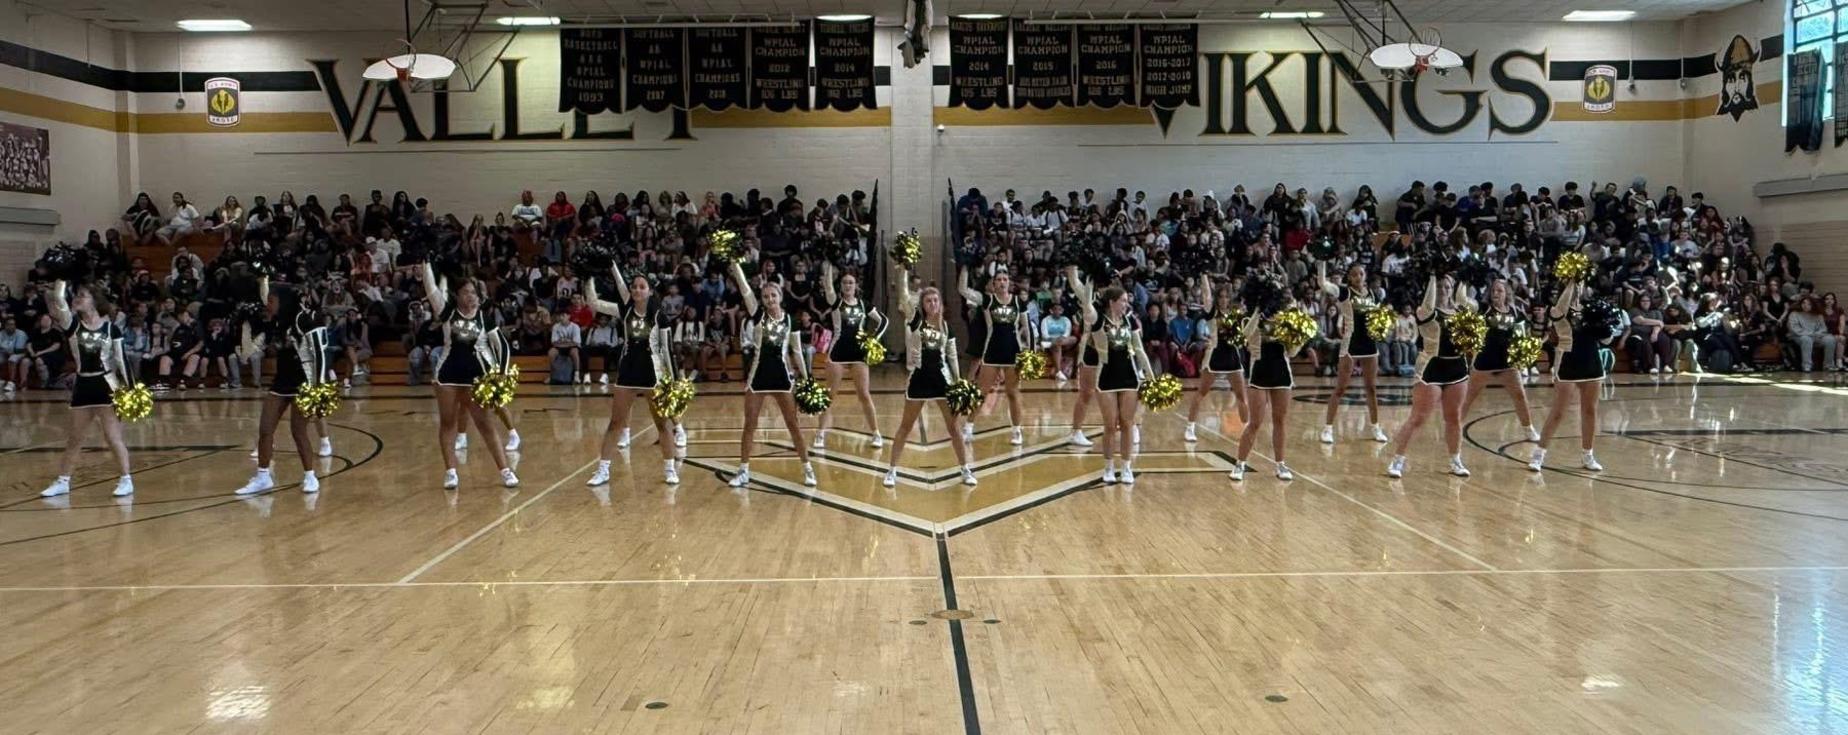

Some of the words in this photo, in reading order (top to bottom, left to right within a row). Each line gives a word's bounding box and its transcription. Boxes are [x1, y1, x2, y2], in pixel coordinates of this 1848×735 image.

[764, 38, 796, 48] WPIAL
[828, 37, 860, 47] WPIAL
[963, 36, 996, 45] WPIAL
[1026, 36, 1060, 45] WPIAL
[1090, 35, 1122, 44] WPIAL
[1153, 35, 1185, 44] WPIAL
[755, 48, 805, 57] CHAMPION
[820, 46, 870, 57] CHAMPION
[954, 45, 1004, 55] CHAMPION
[1018, 45, 1068, 55] CHAMPION
[1081, 43, 1131, 54] CHAMPION
[1144, 45, 1192, 54] CHAMPION
[640, 59, 671, 70] WPIAL
[834, 63, 855, 73] 2014
[968, 61, 989, 71] 2014
[1032, 61, 1054, 71] 2015
[756, 78, 804, 89] WRESTLING
[821, 76, 870, 88] WRESTLING
[955, 76, 1004, 87] WRESTLING
[305, 57, 698, 147] VALL
